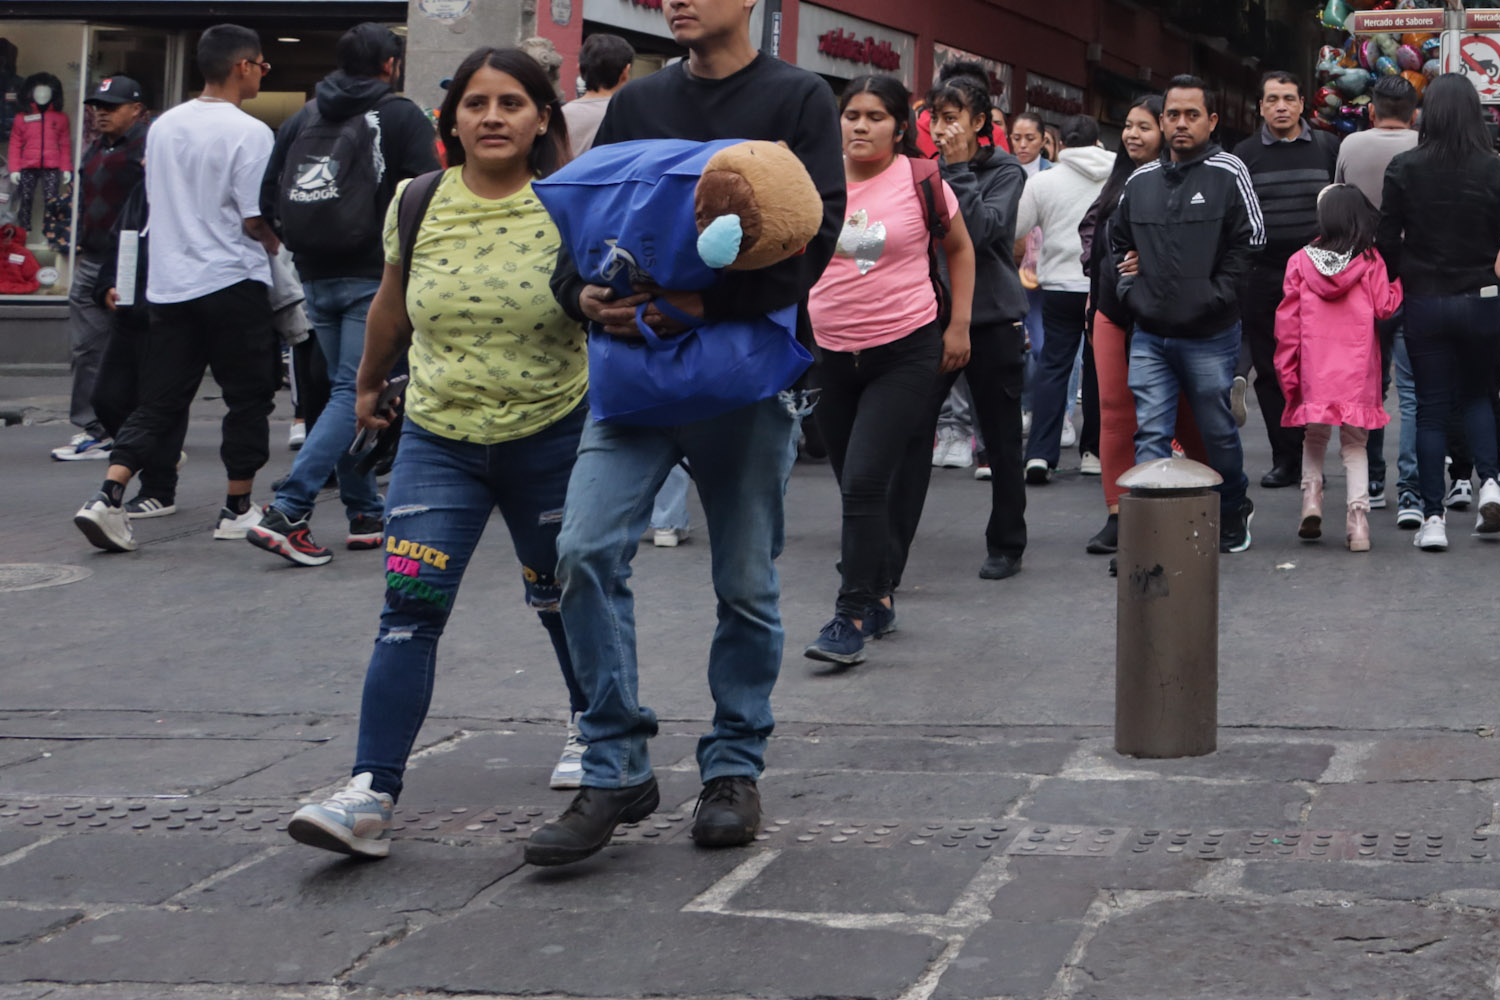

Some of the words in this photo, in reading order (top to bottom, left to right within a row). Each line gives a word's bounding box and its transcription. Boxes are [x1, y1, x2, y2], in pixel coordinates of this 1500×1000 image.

[1364, 18, 1393, 27] Mercado
[1395, 17, 1405, 26] de
[1406, 16, 1433, 25] Sabores
